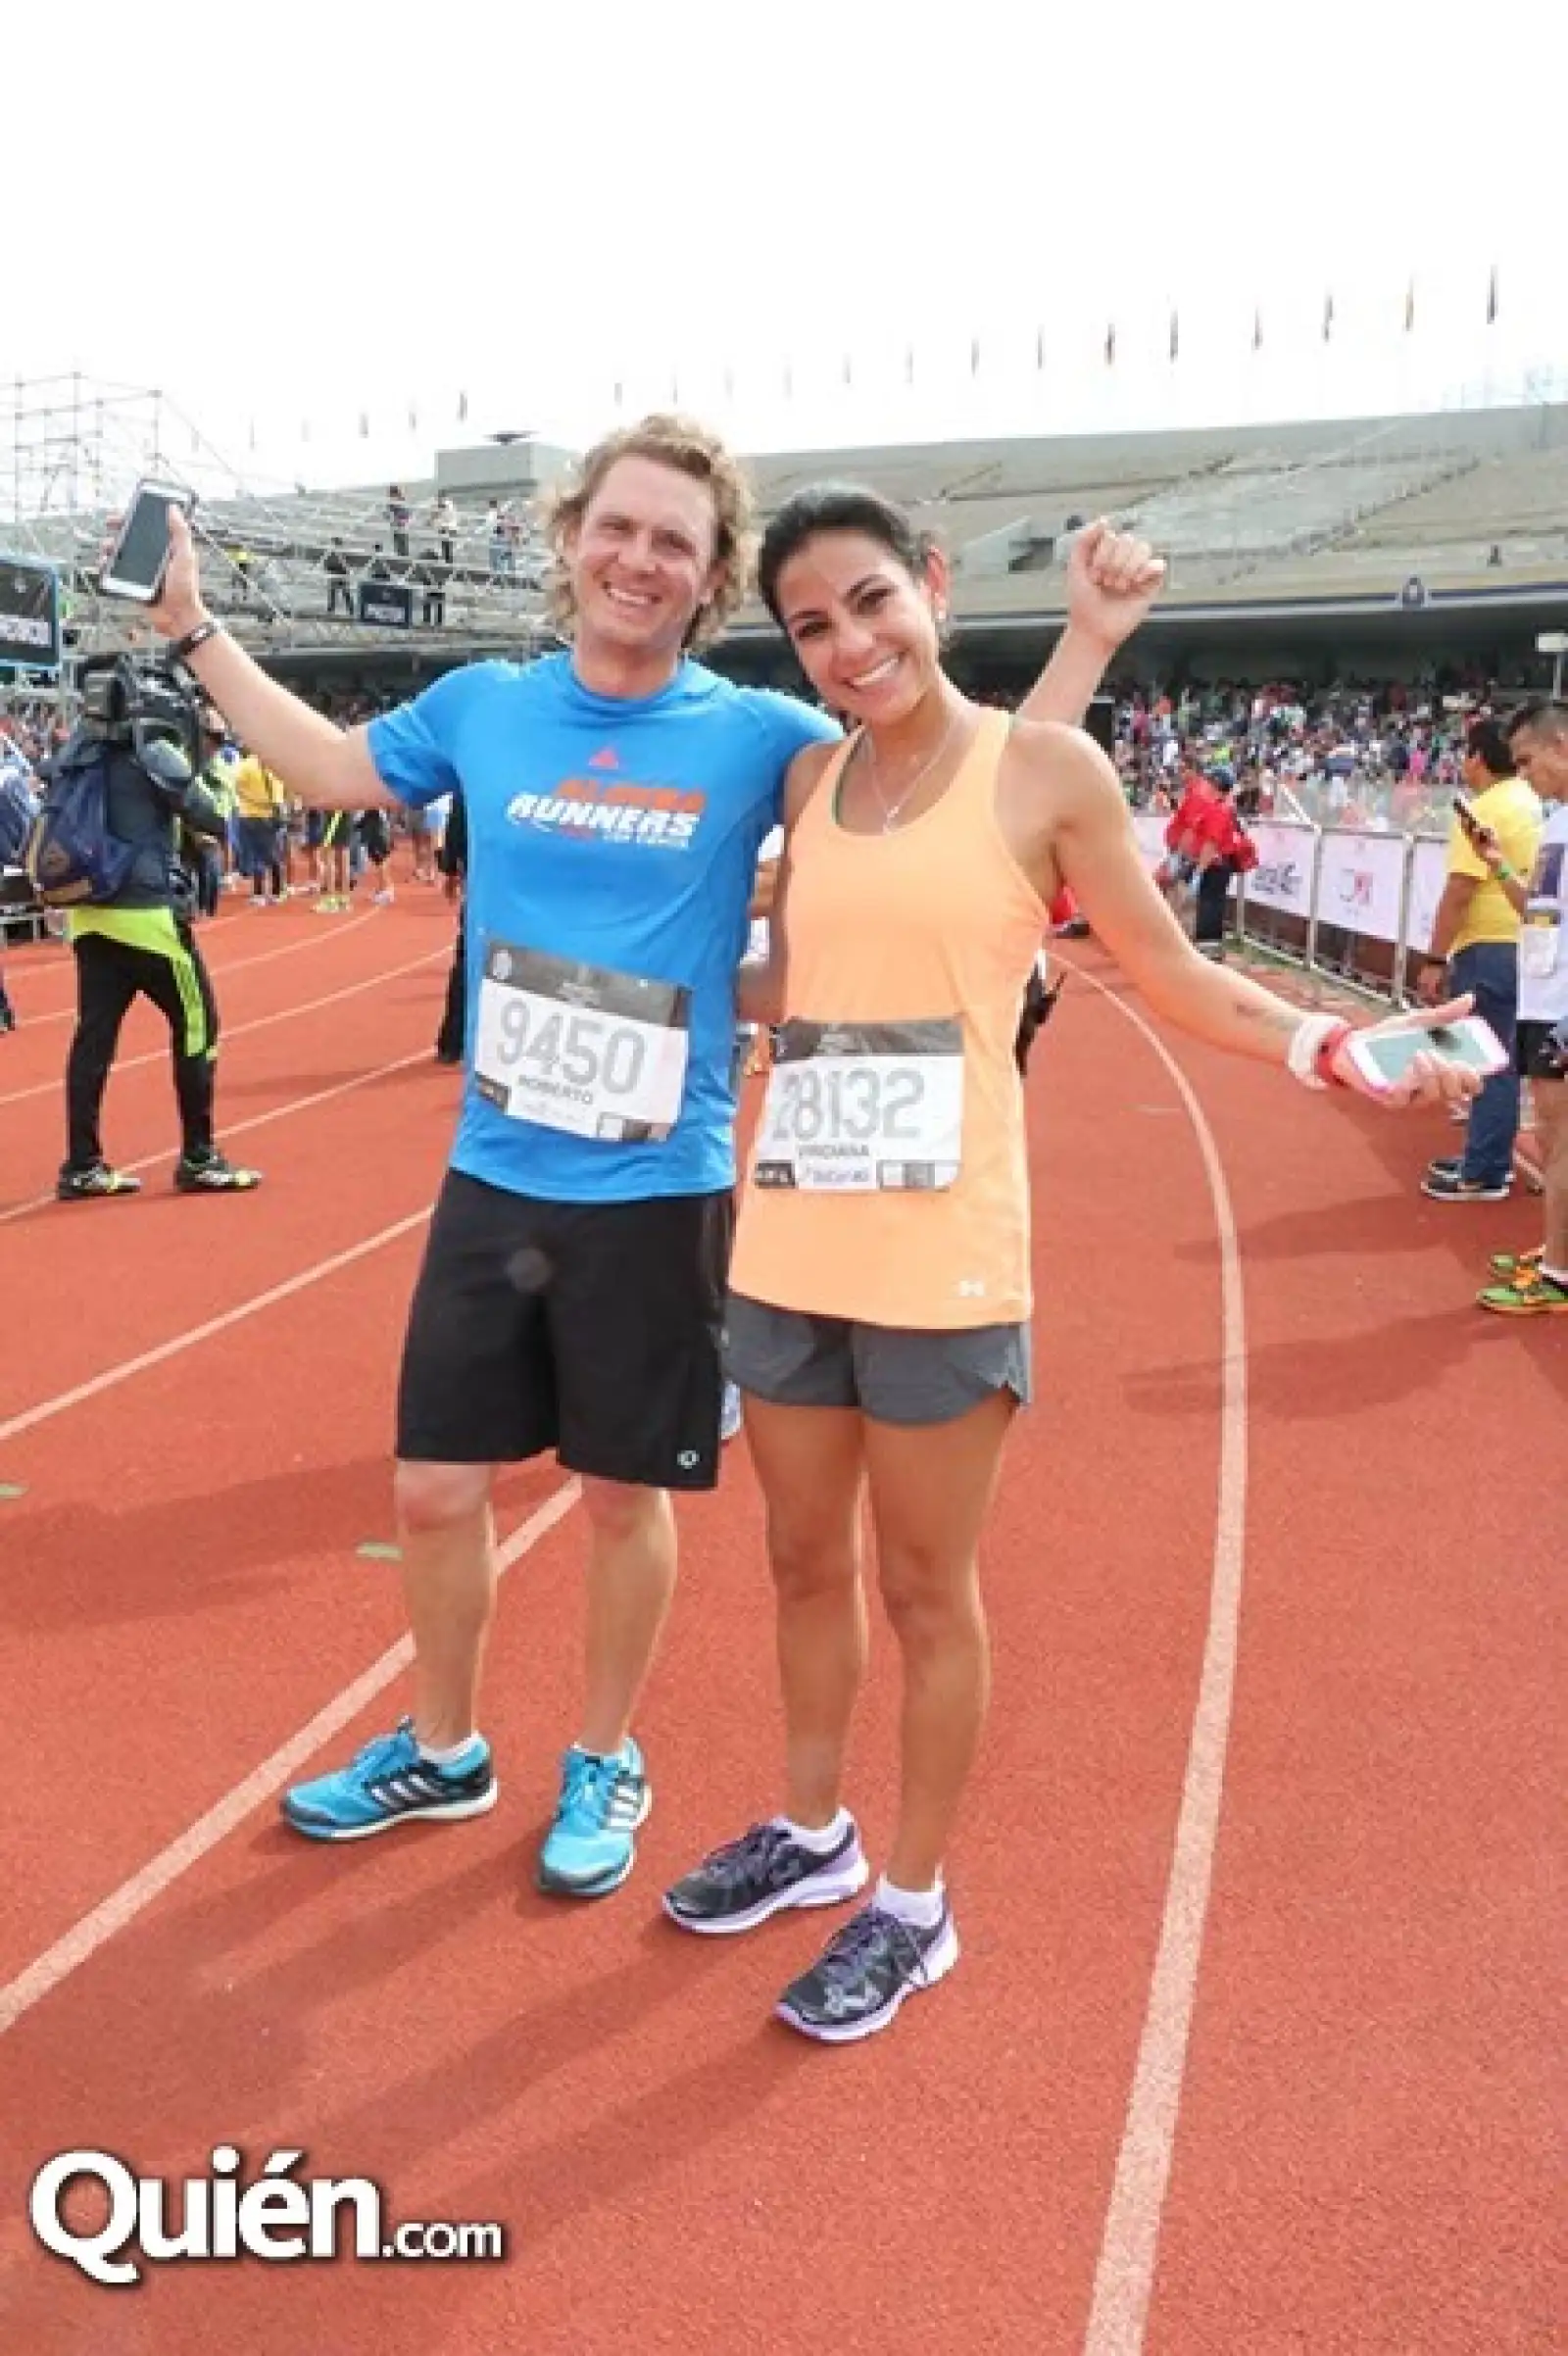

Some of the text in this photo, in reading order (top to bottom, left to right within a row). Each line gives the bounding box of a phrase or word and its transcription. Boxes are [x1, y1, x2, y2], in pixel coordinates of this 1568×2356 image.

[506, 792, 700, 836] RUNNERS
[497, 998, 645, 1094] 9450
[772, 1067, 924, 1140] 28132
